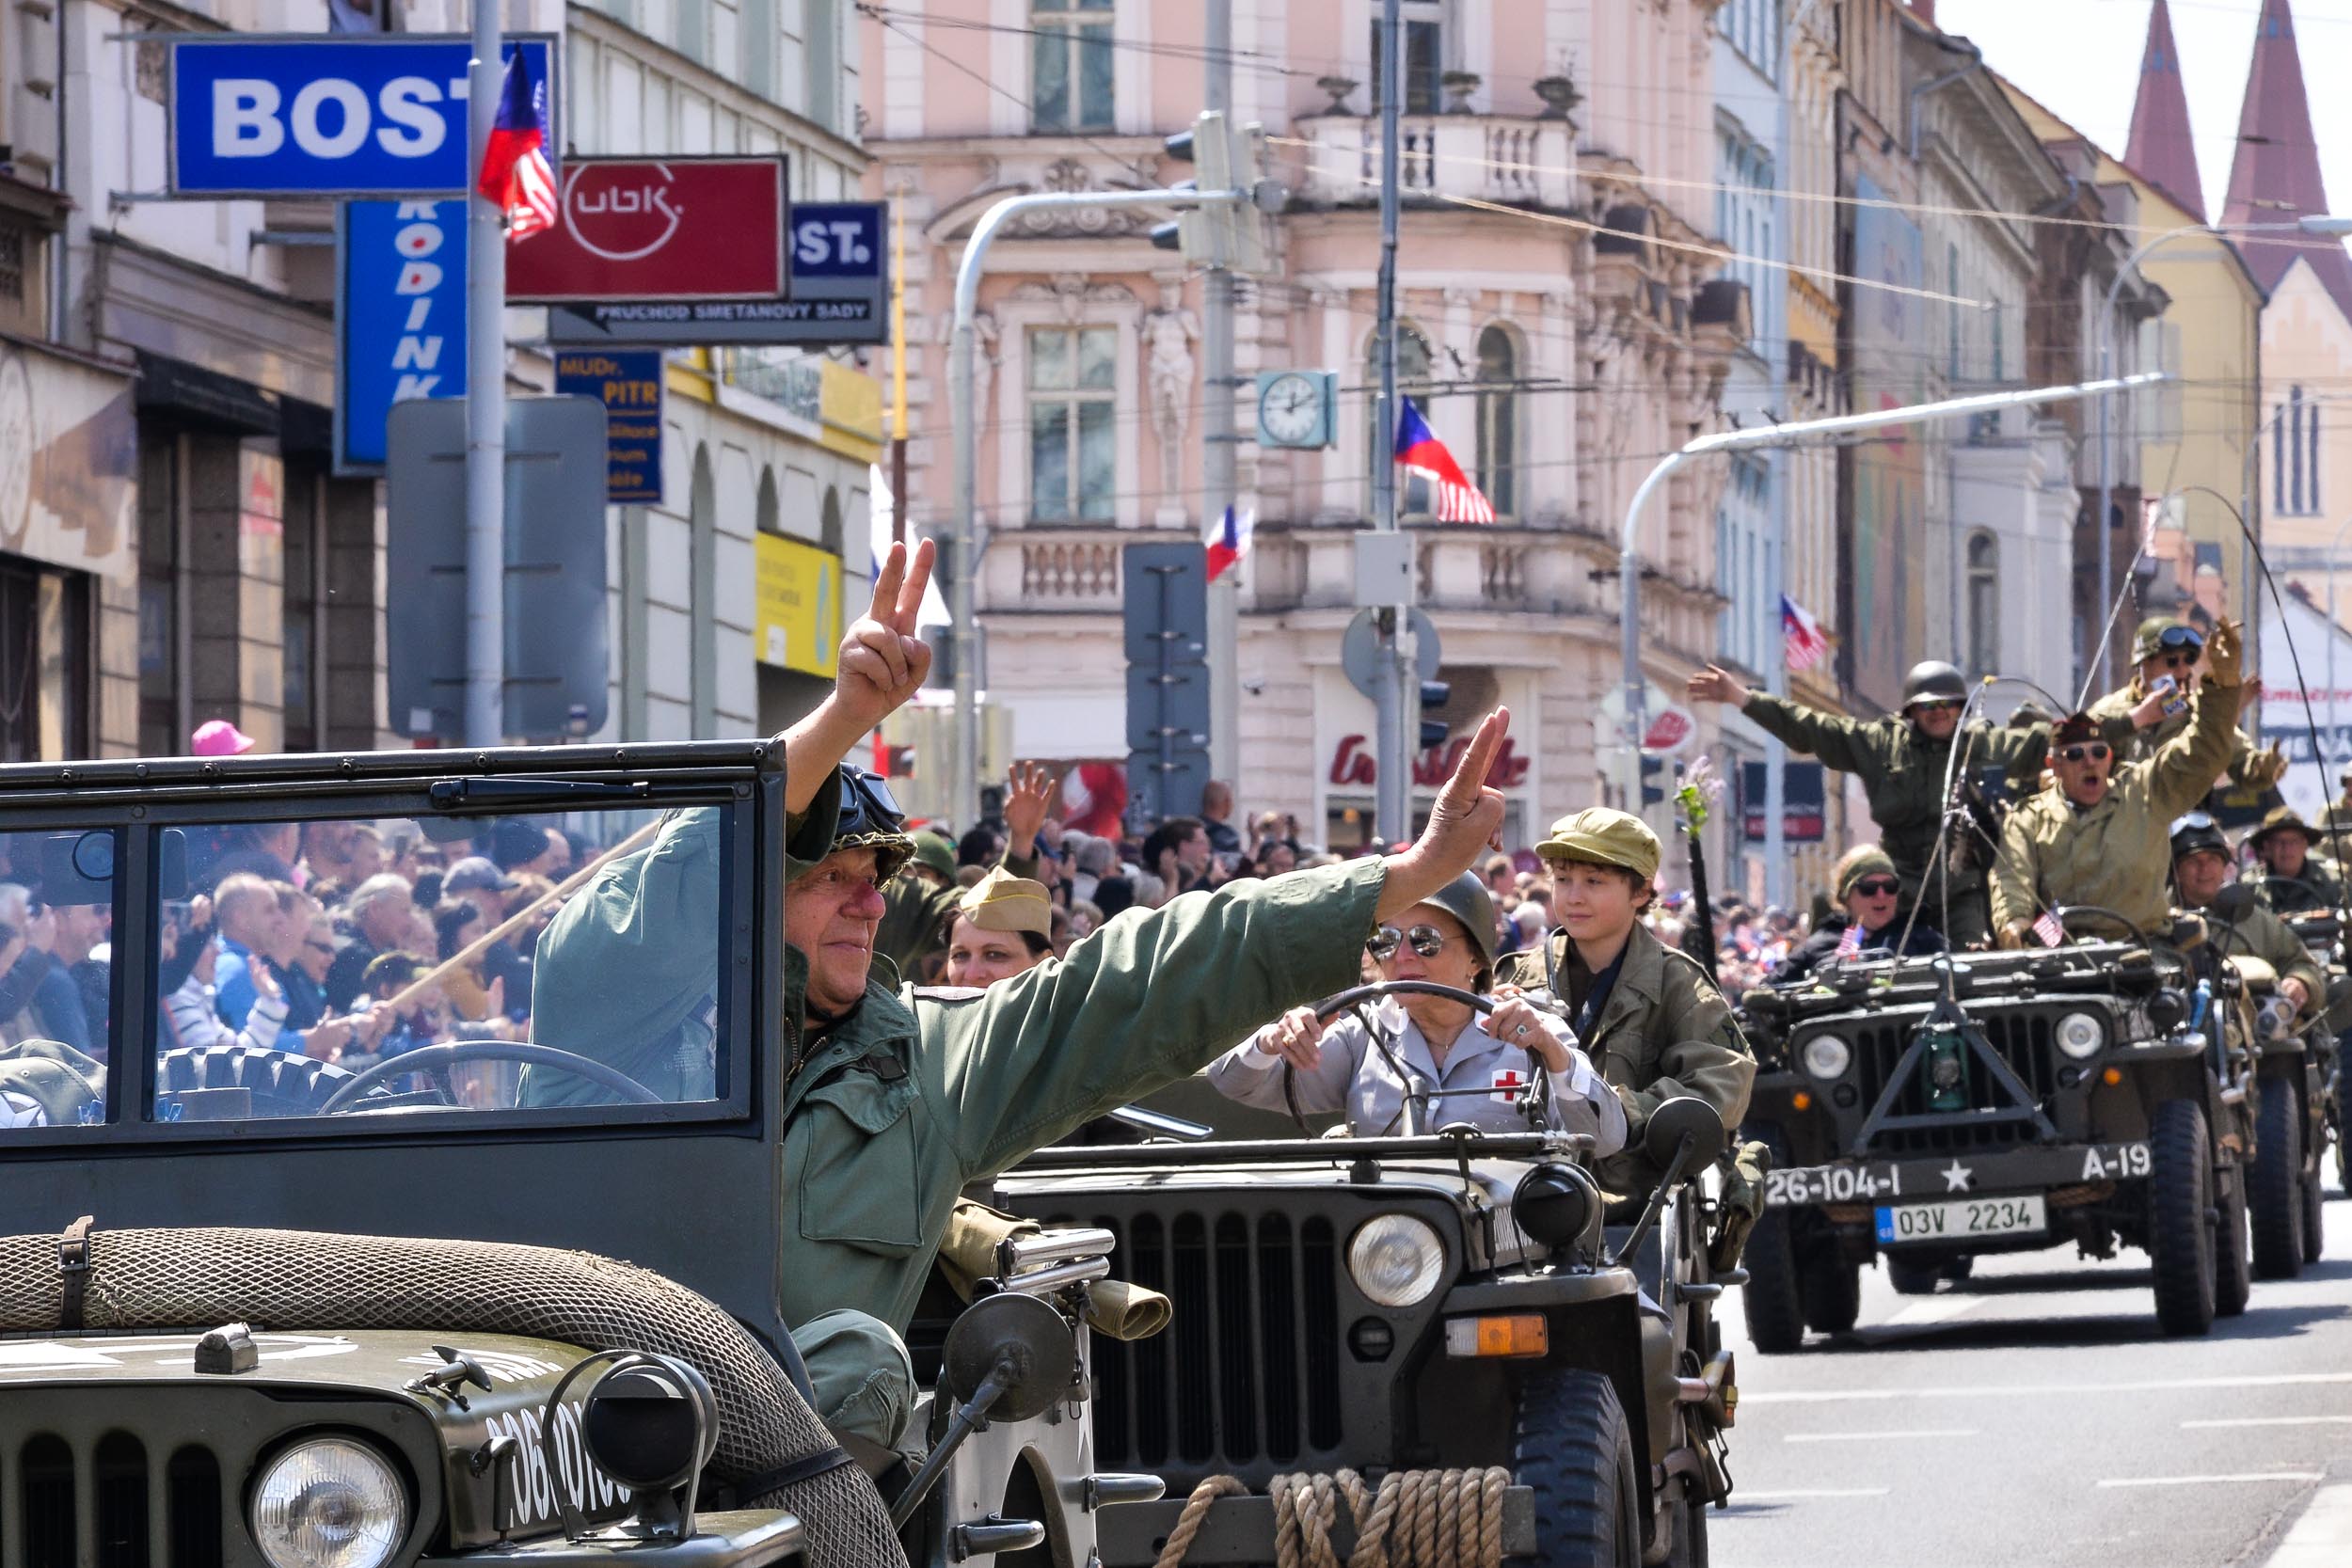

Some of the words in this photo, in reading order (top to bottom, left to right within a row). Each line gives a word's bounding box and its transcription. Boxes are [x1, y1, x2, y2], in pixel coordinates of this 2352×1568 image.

[213, 76, 469, 159] BOS
[788, 221, 871, 264] ST.
[816, 302, 868, 320] SADY
[560, 356, 623, 376] MUDr.
[604, 380, 658, 404] PITR
[2082, 1144, 2152, 1180] A-19
[1899, 1208, 1947, 1235] 03V
[1967, 1201, 2033, 1230] 2234
